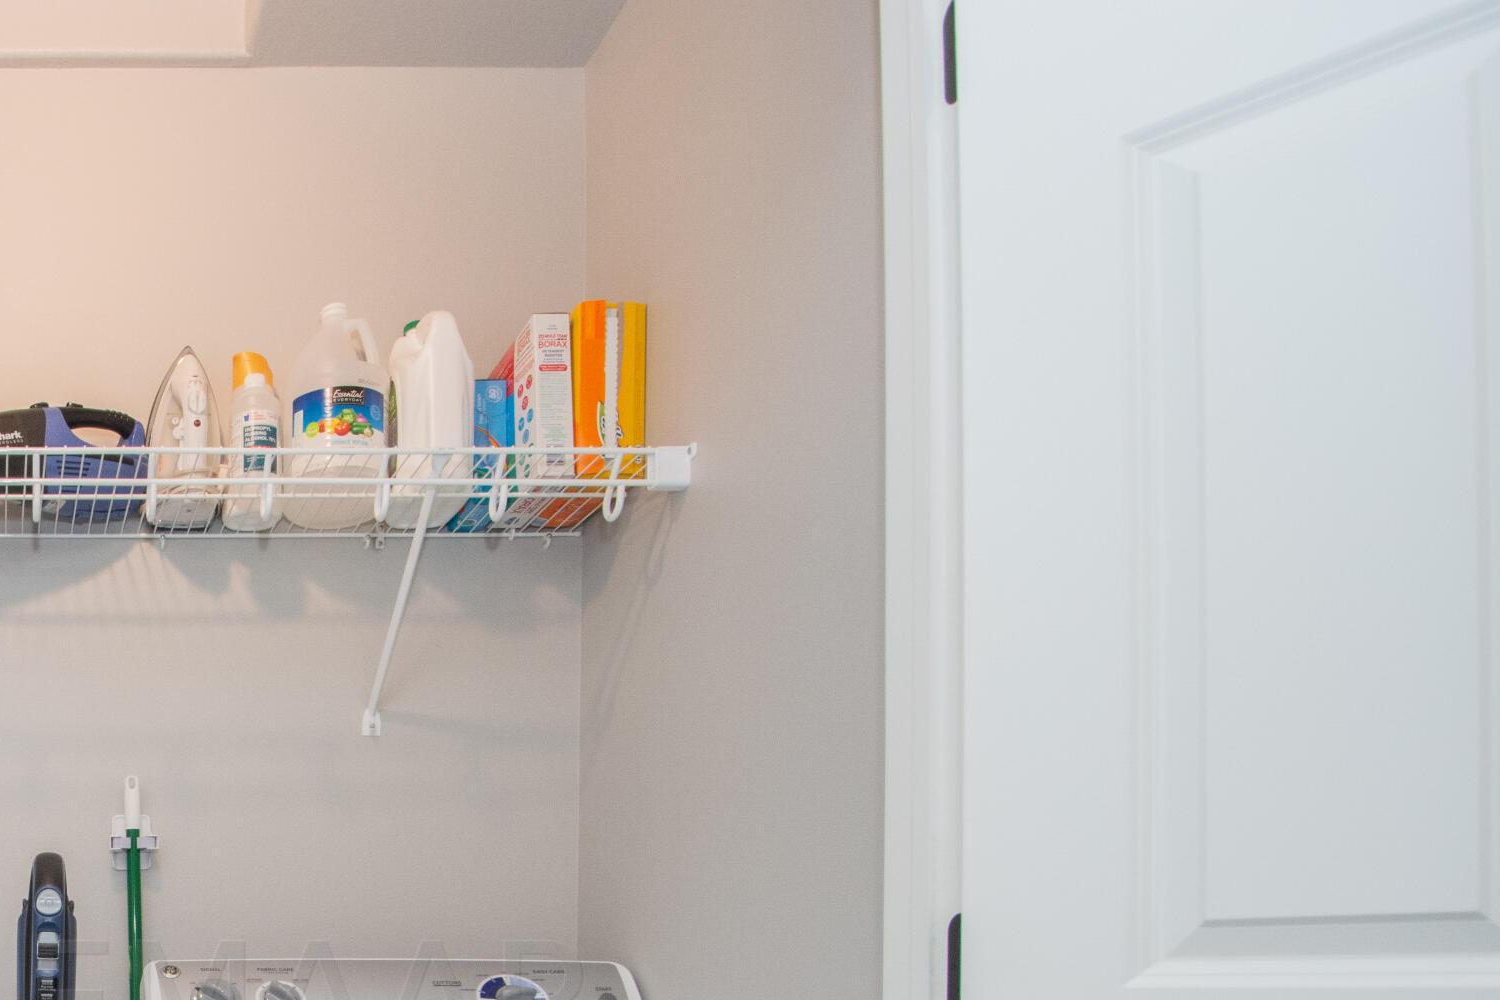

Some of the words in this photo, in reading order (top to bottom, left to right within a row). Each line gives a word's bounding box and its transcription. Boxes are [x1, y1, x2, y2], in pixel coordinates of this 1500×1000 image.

[538, 340, 568, 349] BORAX
[333, 388, 365, 399] Essential
[432, 979, 462, 987] COTTONS
